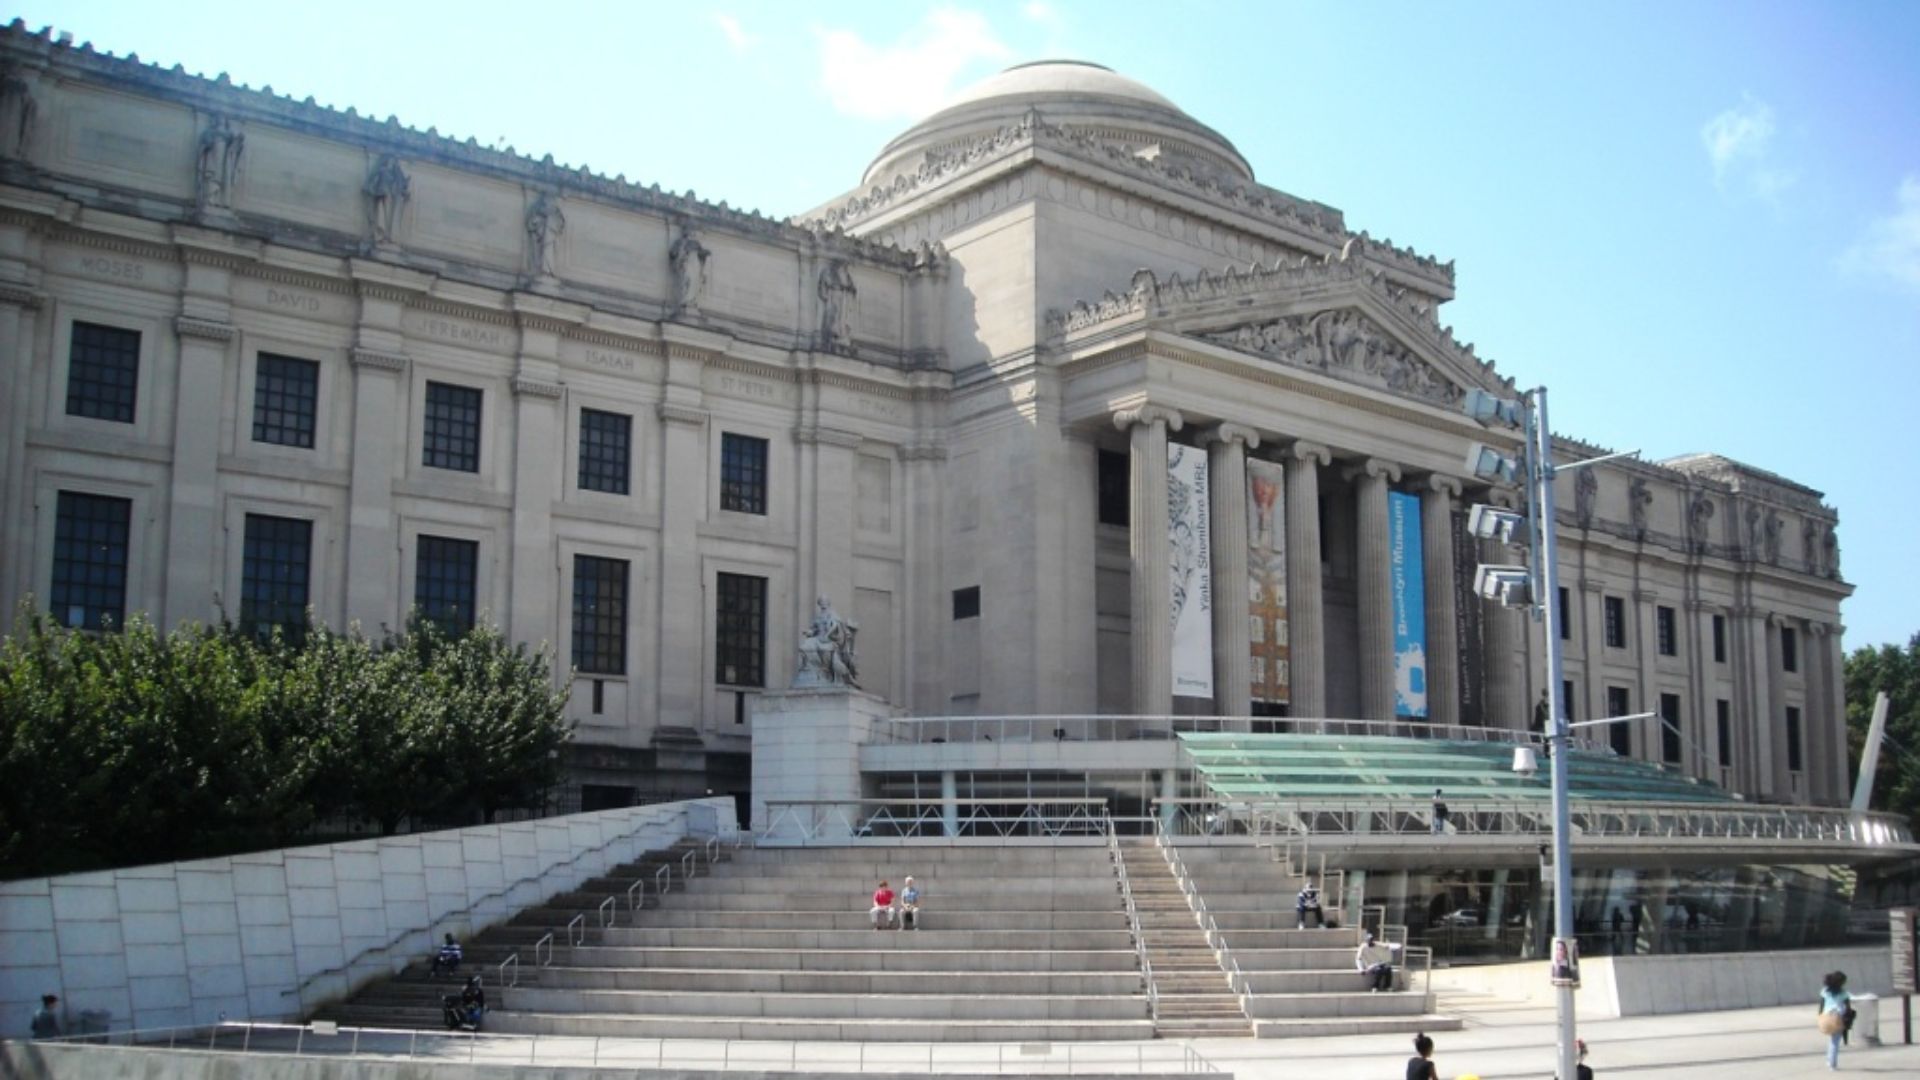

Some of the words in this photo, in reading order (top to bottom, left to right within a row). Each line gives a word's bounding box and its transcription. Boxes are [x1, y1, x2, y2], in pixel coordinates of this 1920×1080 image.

[80, 257, 144, 281] MOSES
[266, 288, 320, 314] DAVID
[585, 349, 635, 370] ISAIAH
[1194, 463, 1206, 494] MBE
[1197, 499, 1208, 569] Shonibare
[1393, 500, 1404, 564] Museum
[1200, 575, 1210, 612] Yinka
[1395, 567, 1408, 636] Brooklyn
